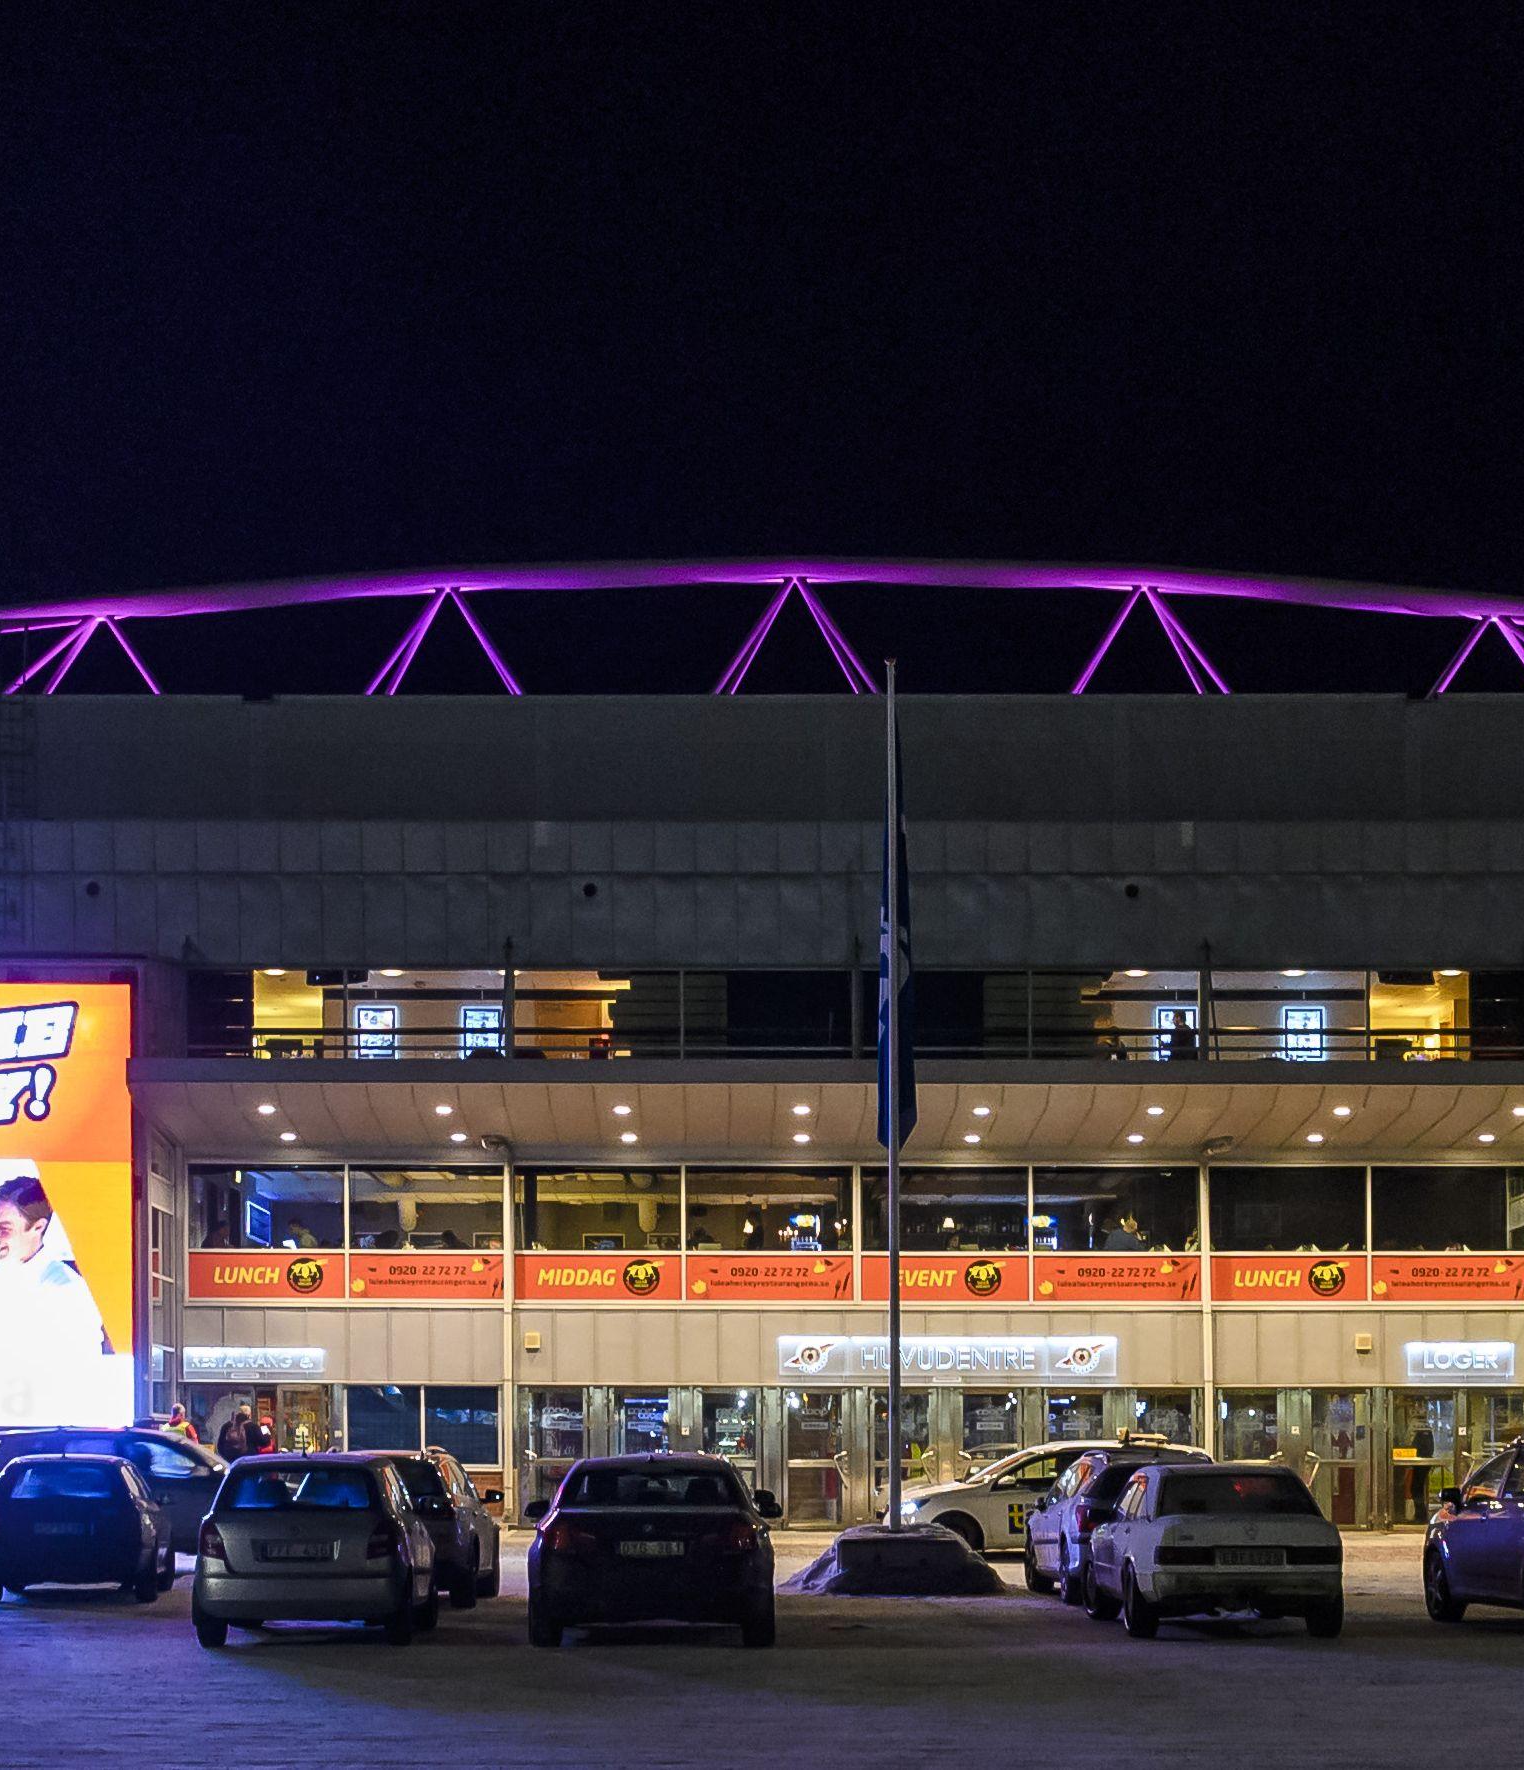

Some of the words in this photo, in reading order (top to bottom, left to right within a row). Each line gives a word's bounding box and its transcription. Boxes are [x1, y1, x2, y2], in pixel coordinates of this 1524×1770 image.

[213, 1266, 280, 1285] LUNCH
[537, 1268, 616, 1286] MIDDAG
[1234, 1269, 1301, 1288] LUNCH
[1423, 1348, 1499, 1370] LOGER
